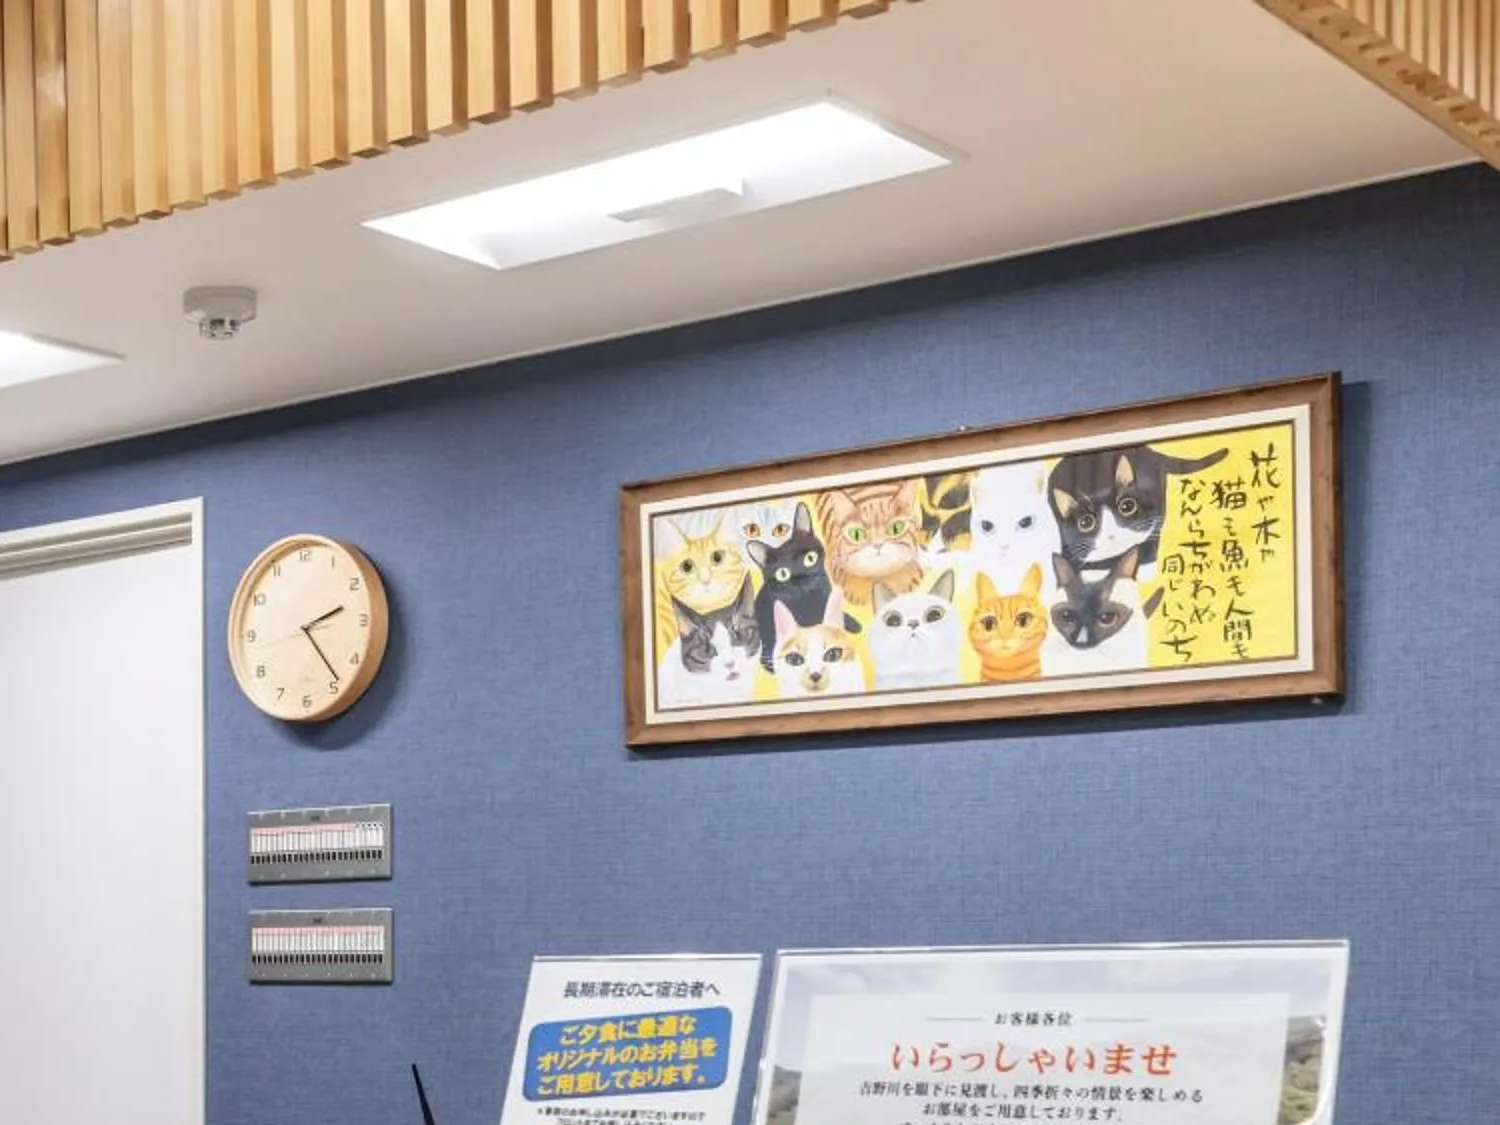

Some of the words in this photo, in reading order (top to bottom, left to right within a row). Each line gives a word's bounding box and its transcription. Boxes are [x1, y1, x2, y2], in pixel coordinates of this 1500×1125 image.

[299, 551, 310, 562] 12
[273, 565, 281, 577] 11
[349, 577, 360, 591] 2
[253, 594, 266, 607] 10
[358, 613, 368, 627] 3
[246, 630, 256, 643] 9
[350, 652, 359, 665] 4
[256, 665, 266, 678] 8
[276, 687, 285, 700] 7
[329, 681, 338, 694] 5
[302, 695, 312, 708] 6
[994, 1011, 1074, 1027] お客様各位
[536, 1036, 718, 1072] オリジナルのお弁当を
[891, 1041, 1179, 1077] いらっしゃいませ
[537, 1063, 706, 1096] ご用意しております。
